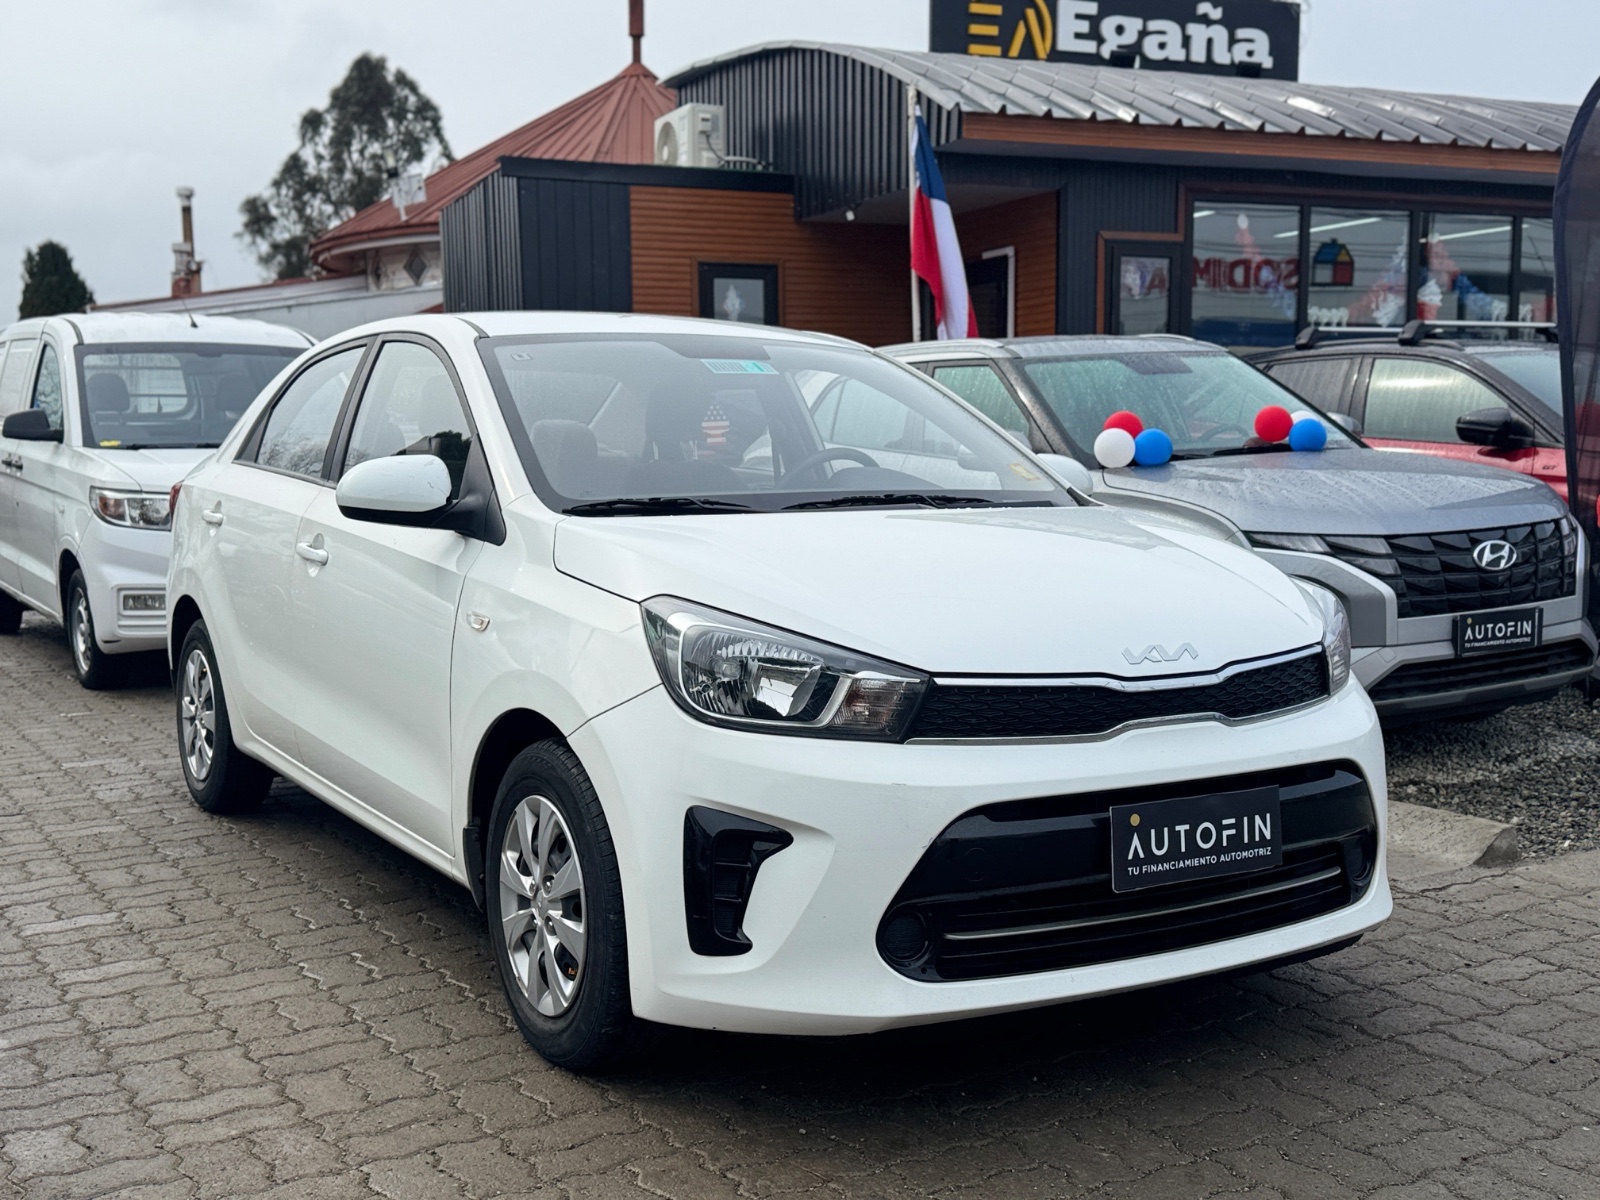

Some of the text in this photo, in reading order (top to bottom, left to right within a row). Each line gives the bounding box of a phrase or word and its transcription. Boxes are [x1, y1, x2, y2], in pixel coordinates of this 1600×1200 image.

[1055, 0, 1274, 70] Egaña
[1464, 617, 1532, 641] AUTOFIN
[1127, 812, 1272, 861] AUTOFIN
[1127, 846, 1272, 876] TU FINANCIAMIENTO AUTOMOTRIZ
